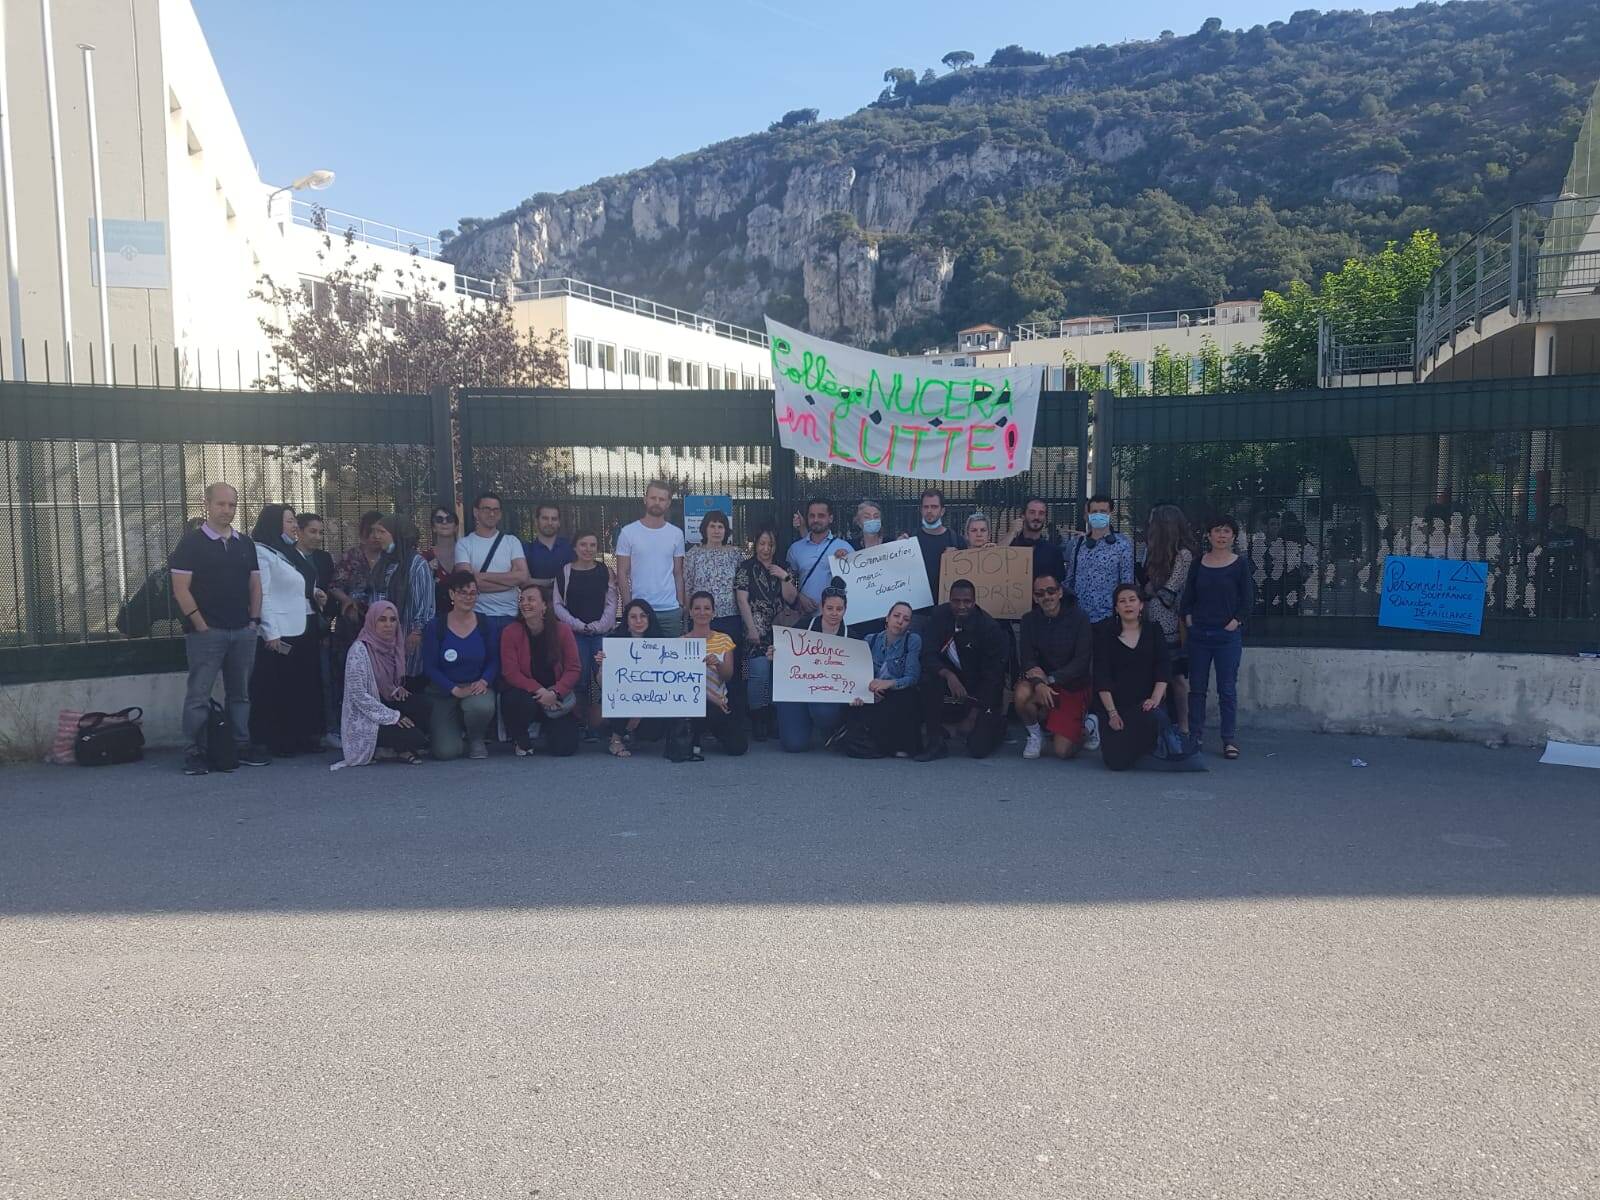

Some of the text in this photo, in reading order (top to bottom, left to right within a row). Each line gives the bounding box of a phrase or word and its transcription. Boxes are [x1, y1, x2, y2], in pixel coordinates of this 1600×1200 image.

[771, 335, 1013, 420] Collège NUCERA
[778, 406, 820, 442] en
[659, 645, 679, 664] fois
[782, 629, 850, 657] Violence
[615, 667, 703, 684] RECTORAT
